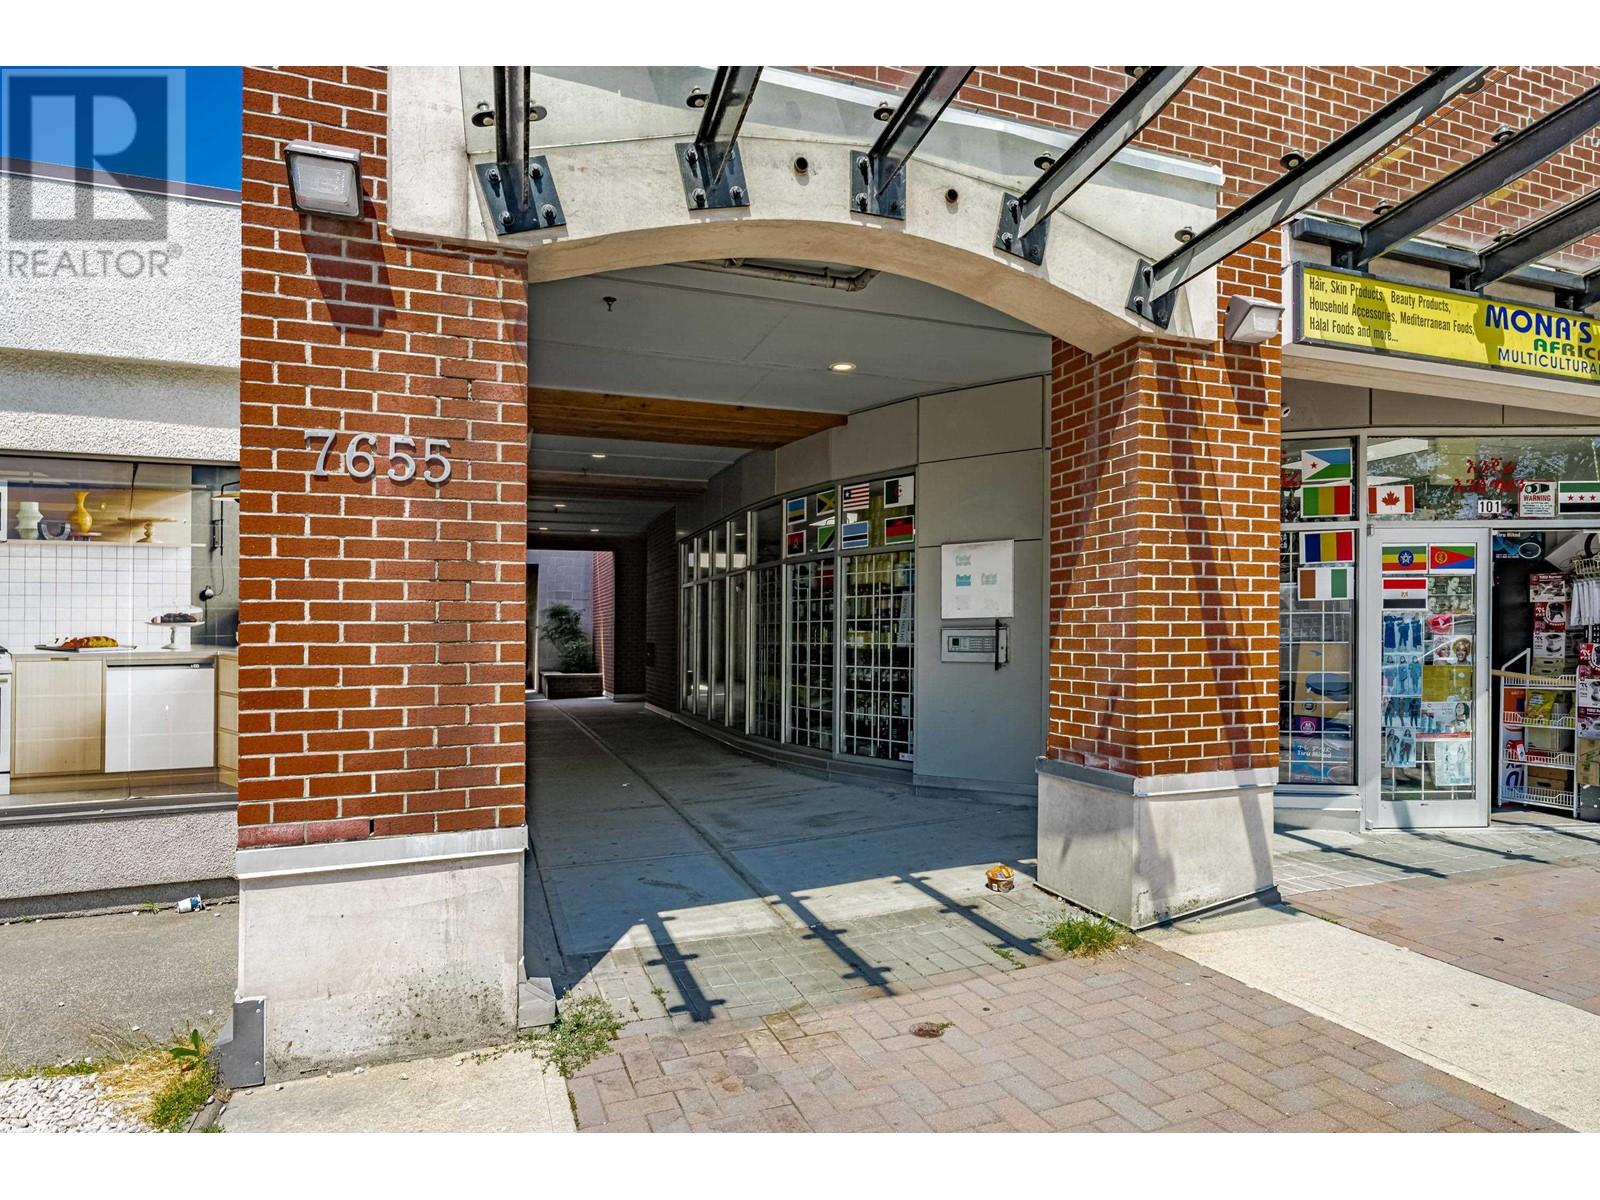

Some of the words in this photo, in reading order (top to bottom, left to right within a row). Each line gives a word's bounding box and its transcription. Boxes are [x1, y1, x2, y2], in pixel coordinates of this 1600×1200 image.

[1309, 276, 1328, 294] Hair,
[1330, 280, 1348, 295] Skin
[1350, 283, 1385, 303] Products,
[1390, 290, 1416, 309] Beauty
[1418, 295, 1451, 314] Products,
[1309, 296, 1349, 315] Household
[1351, 303, 1398, 325] Accessories,
[1400, 311, 1451, 331] Mediterranean
[1453, 320, 1475, 336] Foods,
[1309, 316, 1329, 332] Halal
[1332, 320, 1355, 336] Foods
[1357, 325, 1371, 338] and
[1373, 329, 1399, 343] more...
[1485, 304, 1592, 344] MONA'S
[1533, 338, 1600, 362] AFRIC
[303, 428, 452, 484] 7655
[1480, 501, 1500, 513] 101
[1523, 494, 1552, 502] WARNING
